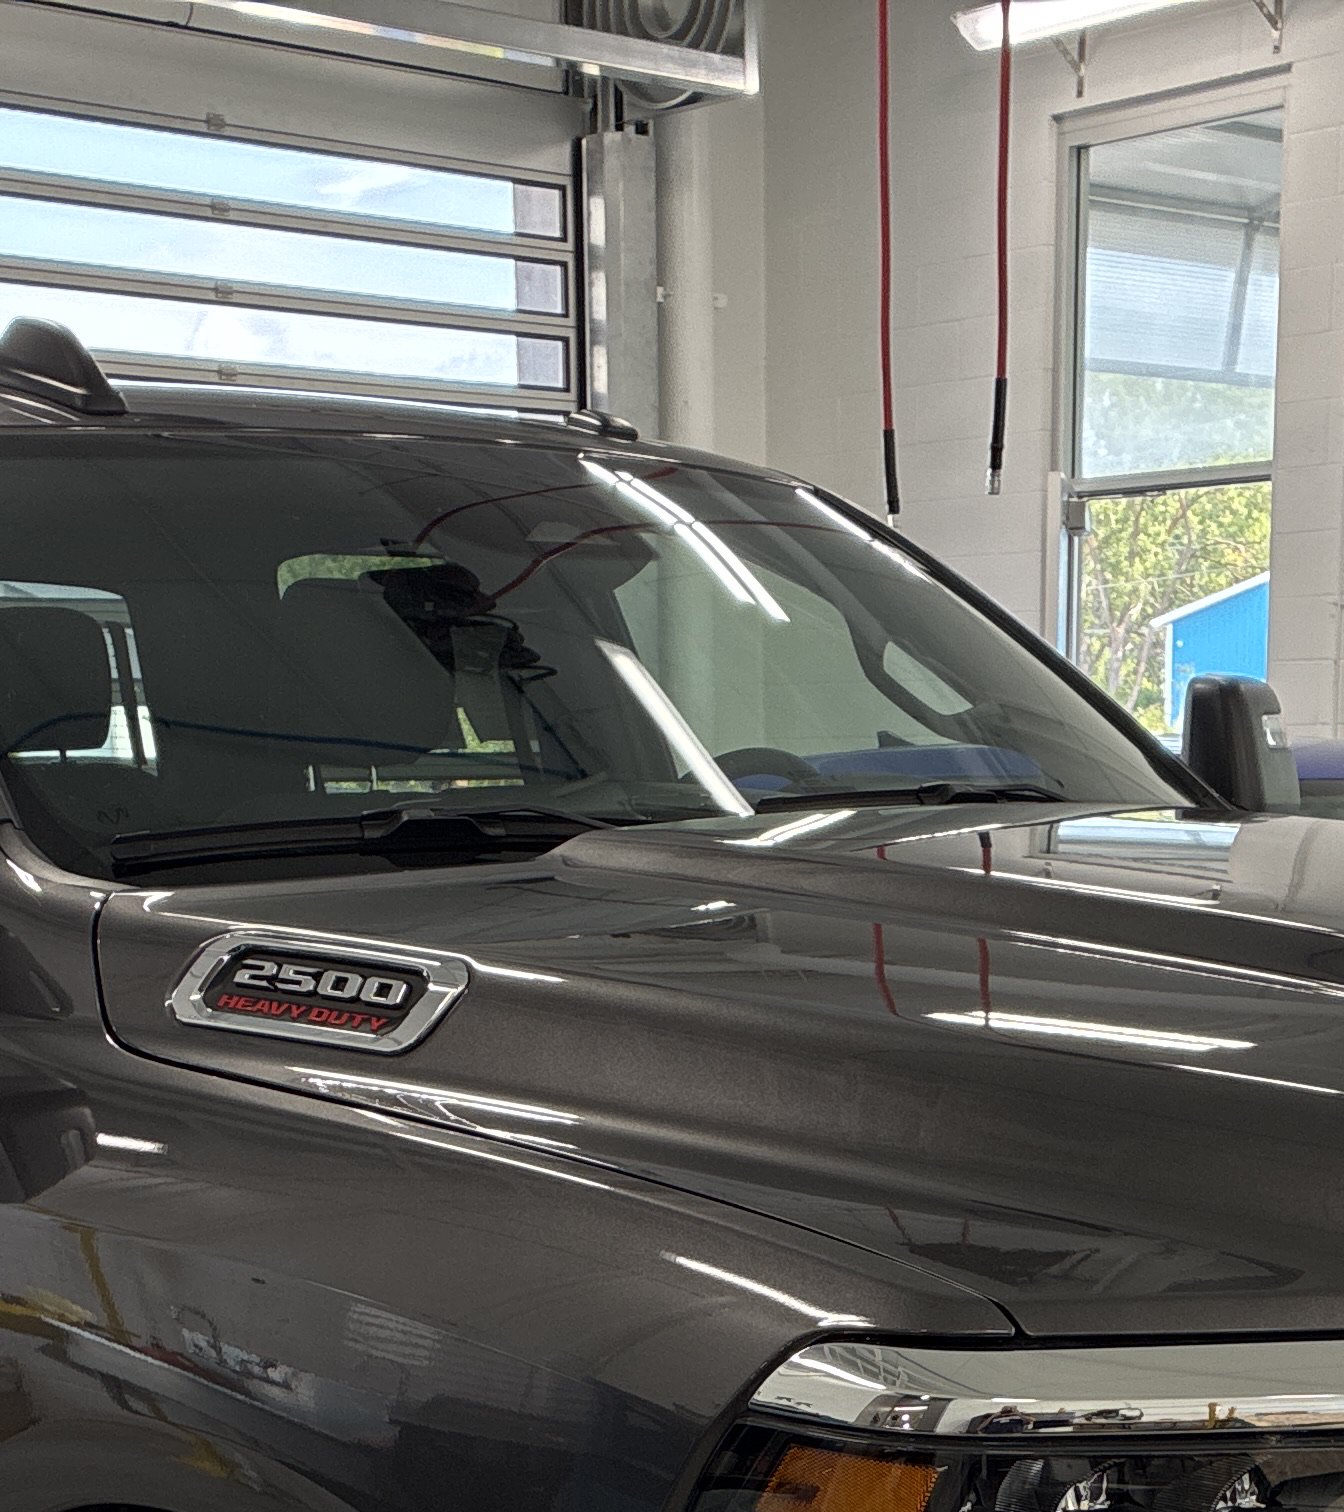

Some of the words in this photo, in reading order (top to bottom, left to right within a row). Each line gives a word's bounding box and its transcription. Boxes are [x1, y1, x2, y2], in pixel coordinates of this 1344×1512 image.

[232, 958, 409, 1005] 2500
[218, 995, 305, 1019] HEAVY
[309, 1008, 390, 1032] DUTY
